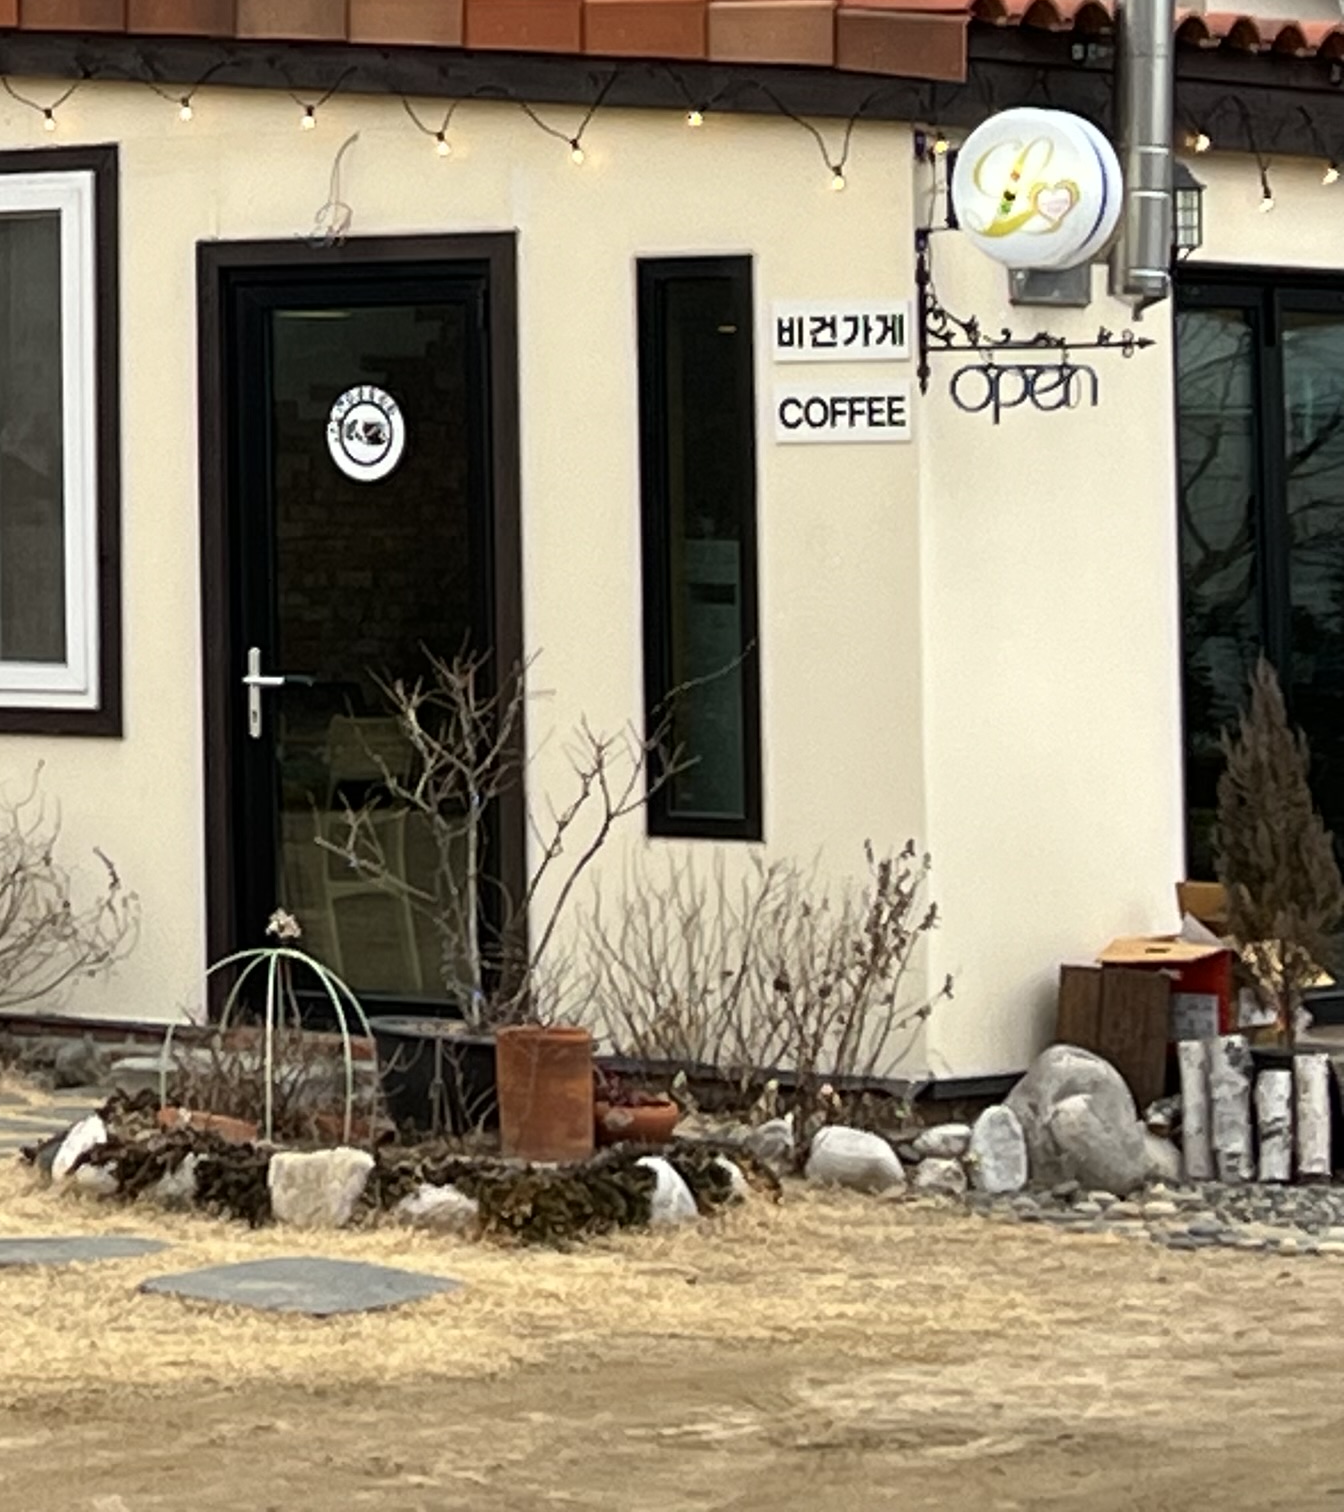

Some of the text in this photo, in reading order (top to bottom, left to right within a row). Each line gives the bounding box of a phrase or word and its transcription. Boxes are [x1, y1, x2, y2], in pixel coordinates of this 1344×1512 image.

[776, 313, 905, 348] 비건가게
[950, 363, 1099, 424] open
[779, 396, 906, 430] COFFEE
